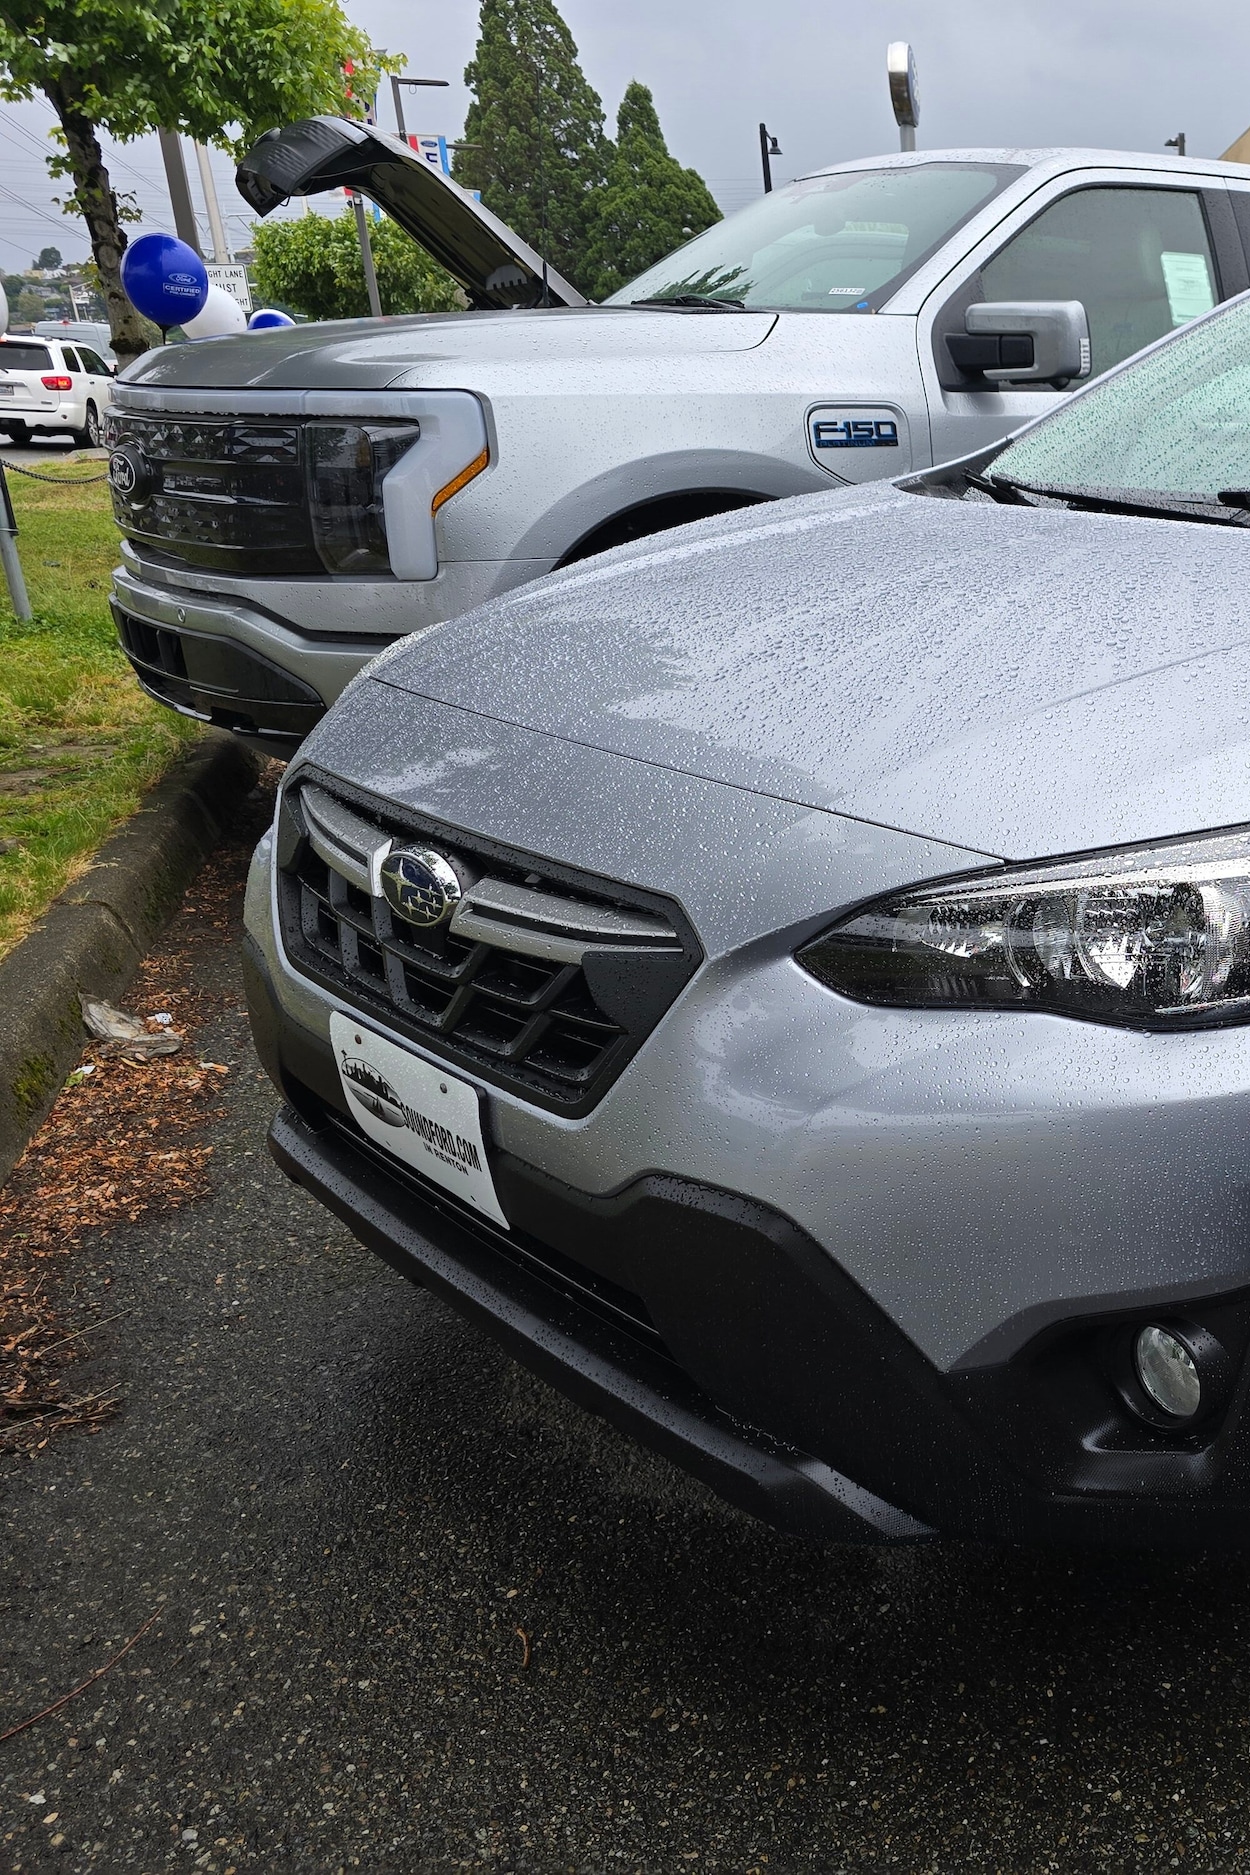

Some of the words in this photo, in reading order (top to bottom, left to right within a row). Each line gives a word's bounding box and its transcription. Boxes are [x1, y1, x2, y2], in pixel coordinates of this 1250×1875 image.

[208, 270, 222, 278] GHT
[224, 270, 244, 278] LANE
[165, 284, 200, 294] CERTIFIED
[813, 421, 898, 440] F-150
[112, 457, 131, 487] Ford
[400, 1101, 483, 1173] SOUNDFORD.COM
